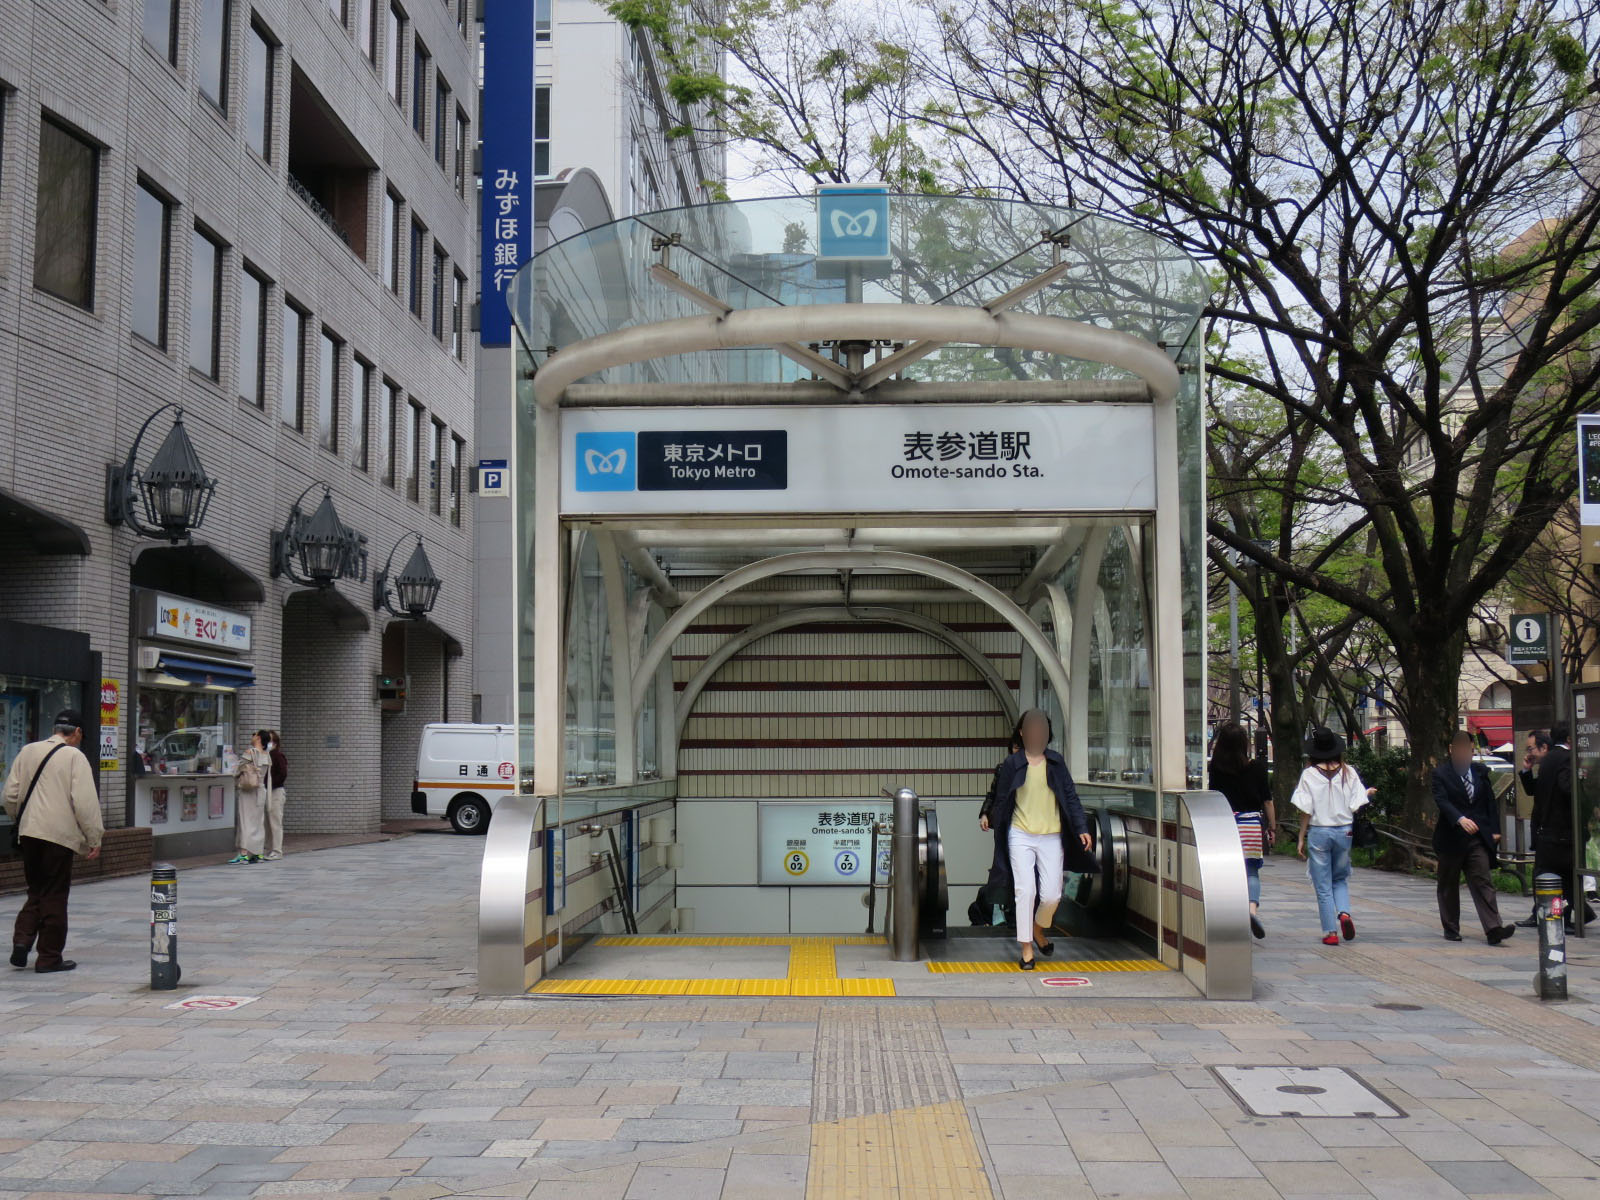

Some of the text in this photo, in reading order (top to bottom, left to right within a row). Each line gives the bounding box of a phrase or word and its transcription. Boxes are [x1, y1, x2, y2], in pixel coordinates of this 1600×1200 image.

[494, 169, 519, 292] みずほ銀行
[903, 430, 1032, 461] 表参道駅
[663, 444, 762, 462] 東京メトロ
[669, 465, 756, 480] Tokyo Metro
[891, 463, 1045, 479] Omote-sando Sta.
[1577, 723, 1599, 735] SMOKING
[1578, 736, 1590, 748] AREA
[818, 812, 875, 826] 表参道駅
[812, 827, 865, 835] Omote-sando
[793, 854, 800, 862] G
[844, 854, 850, 862] Z
[790, 862, 803, 870] 02
[840, 862, 853, 870] 02
